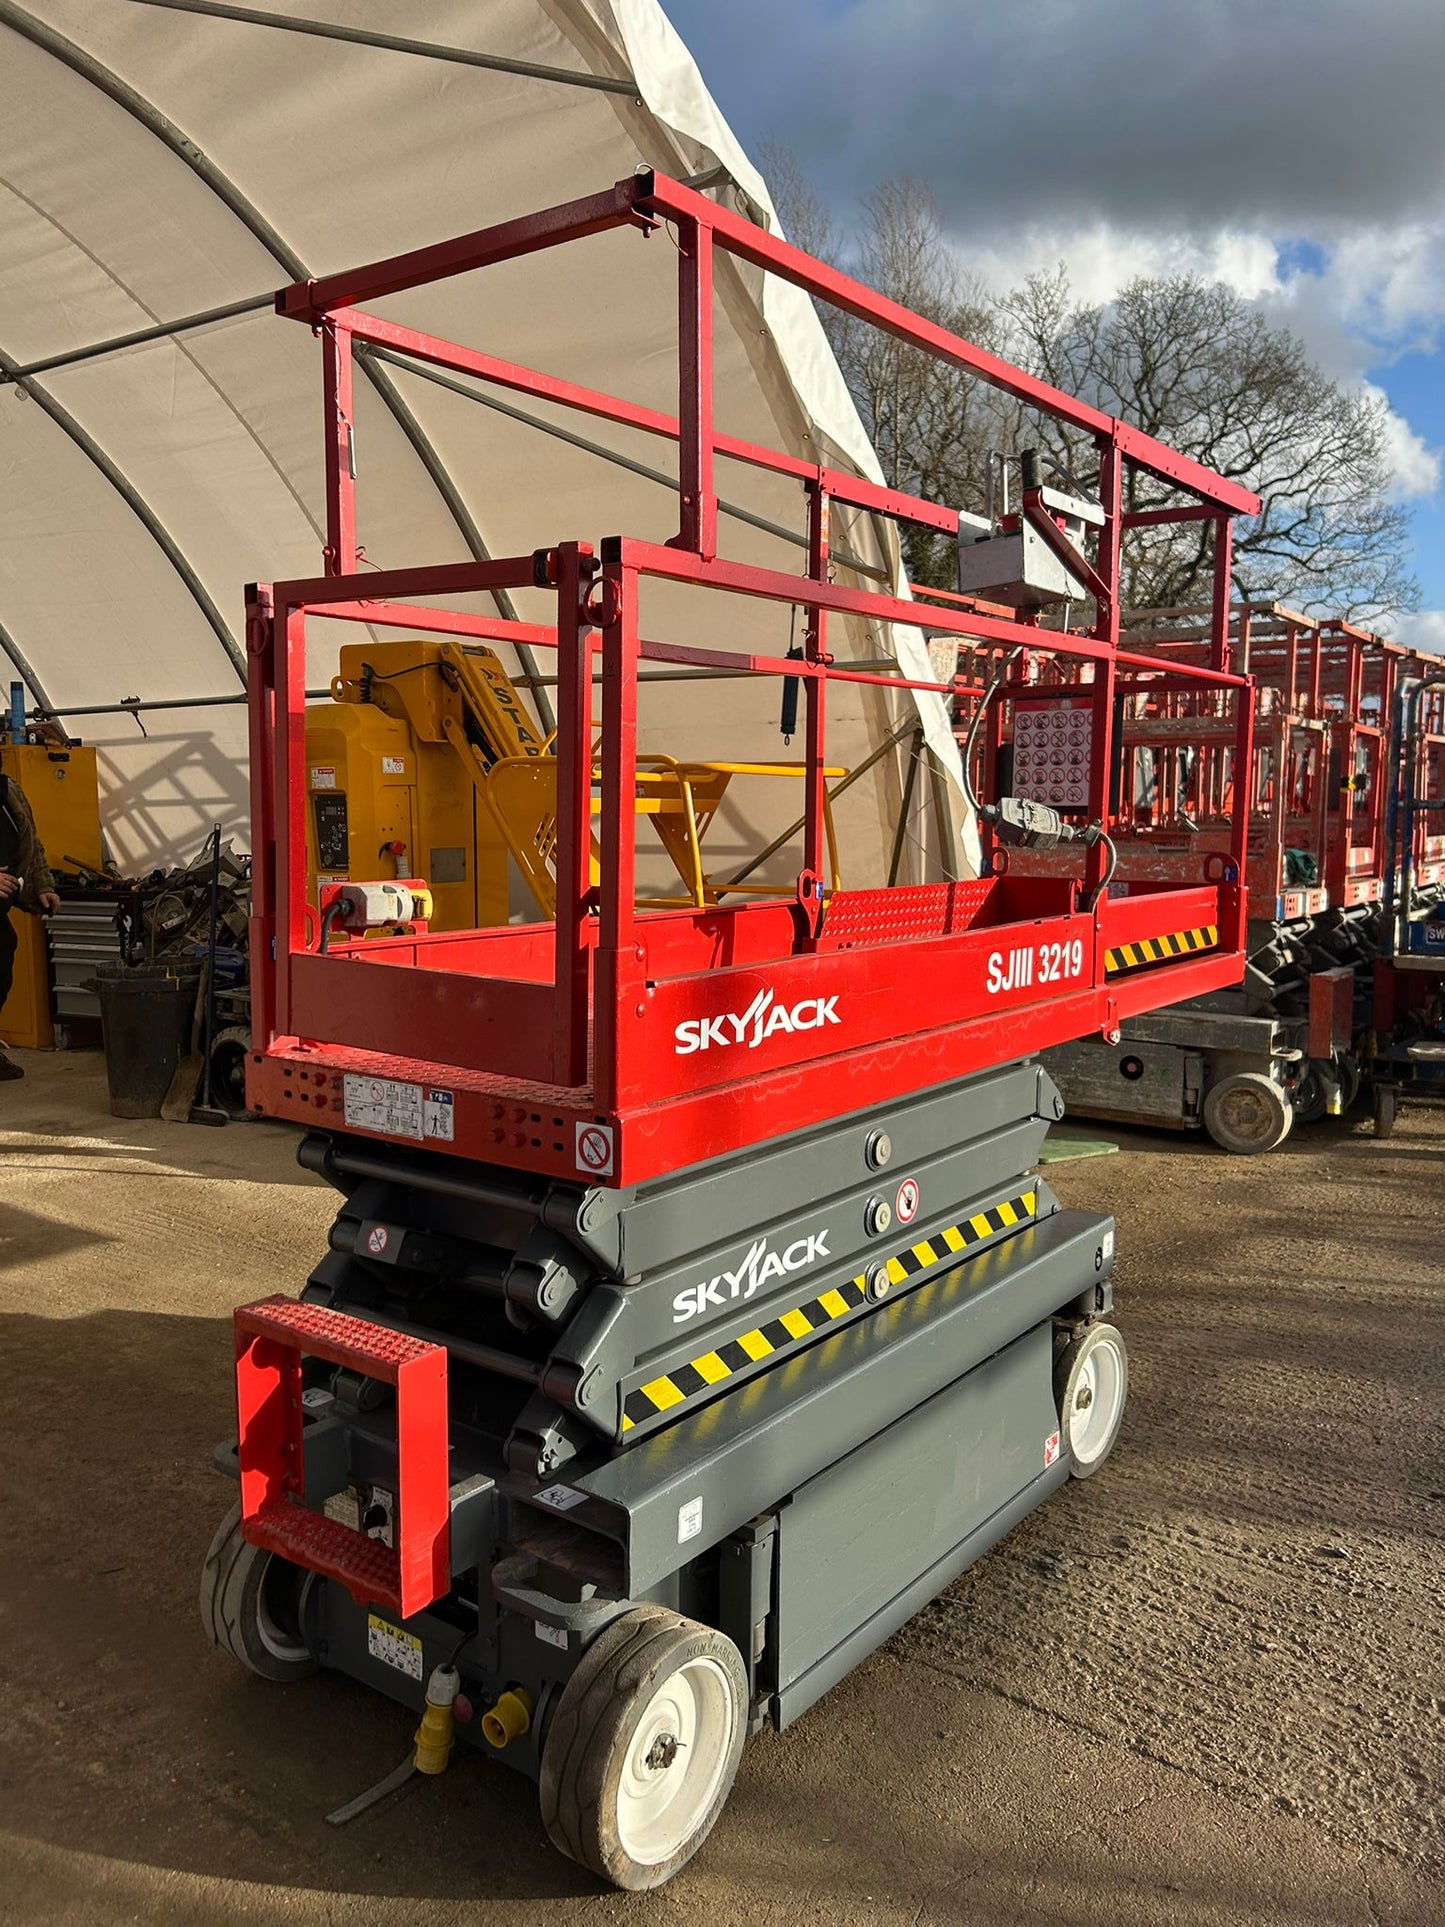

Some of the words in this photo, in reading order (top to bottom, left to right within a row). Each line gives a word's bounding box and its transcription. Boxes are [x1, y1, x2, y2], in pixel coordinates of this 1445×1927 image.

[986, 945, 1034, 994] SJIII
[1037, 938, 1083, 984] 3219
[674, 986, 842, 1055] SKYJACK
[672, 1228, 832, 1324] SKYJACK
